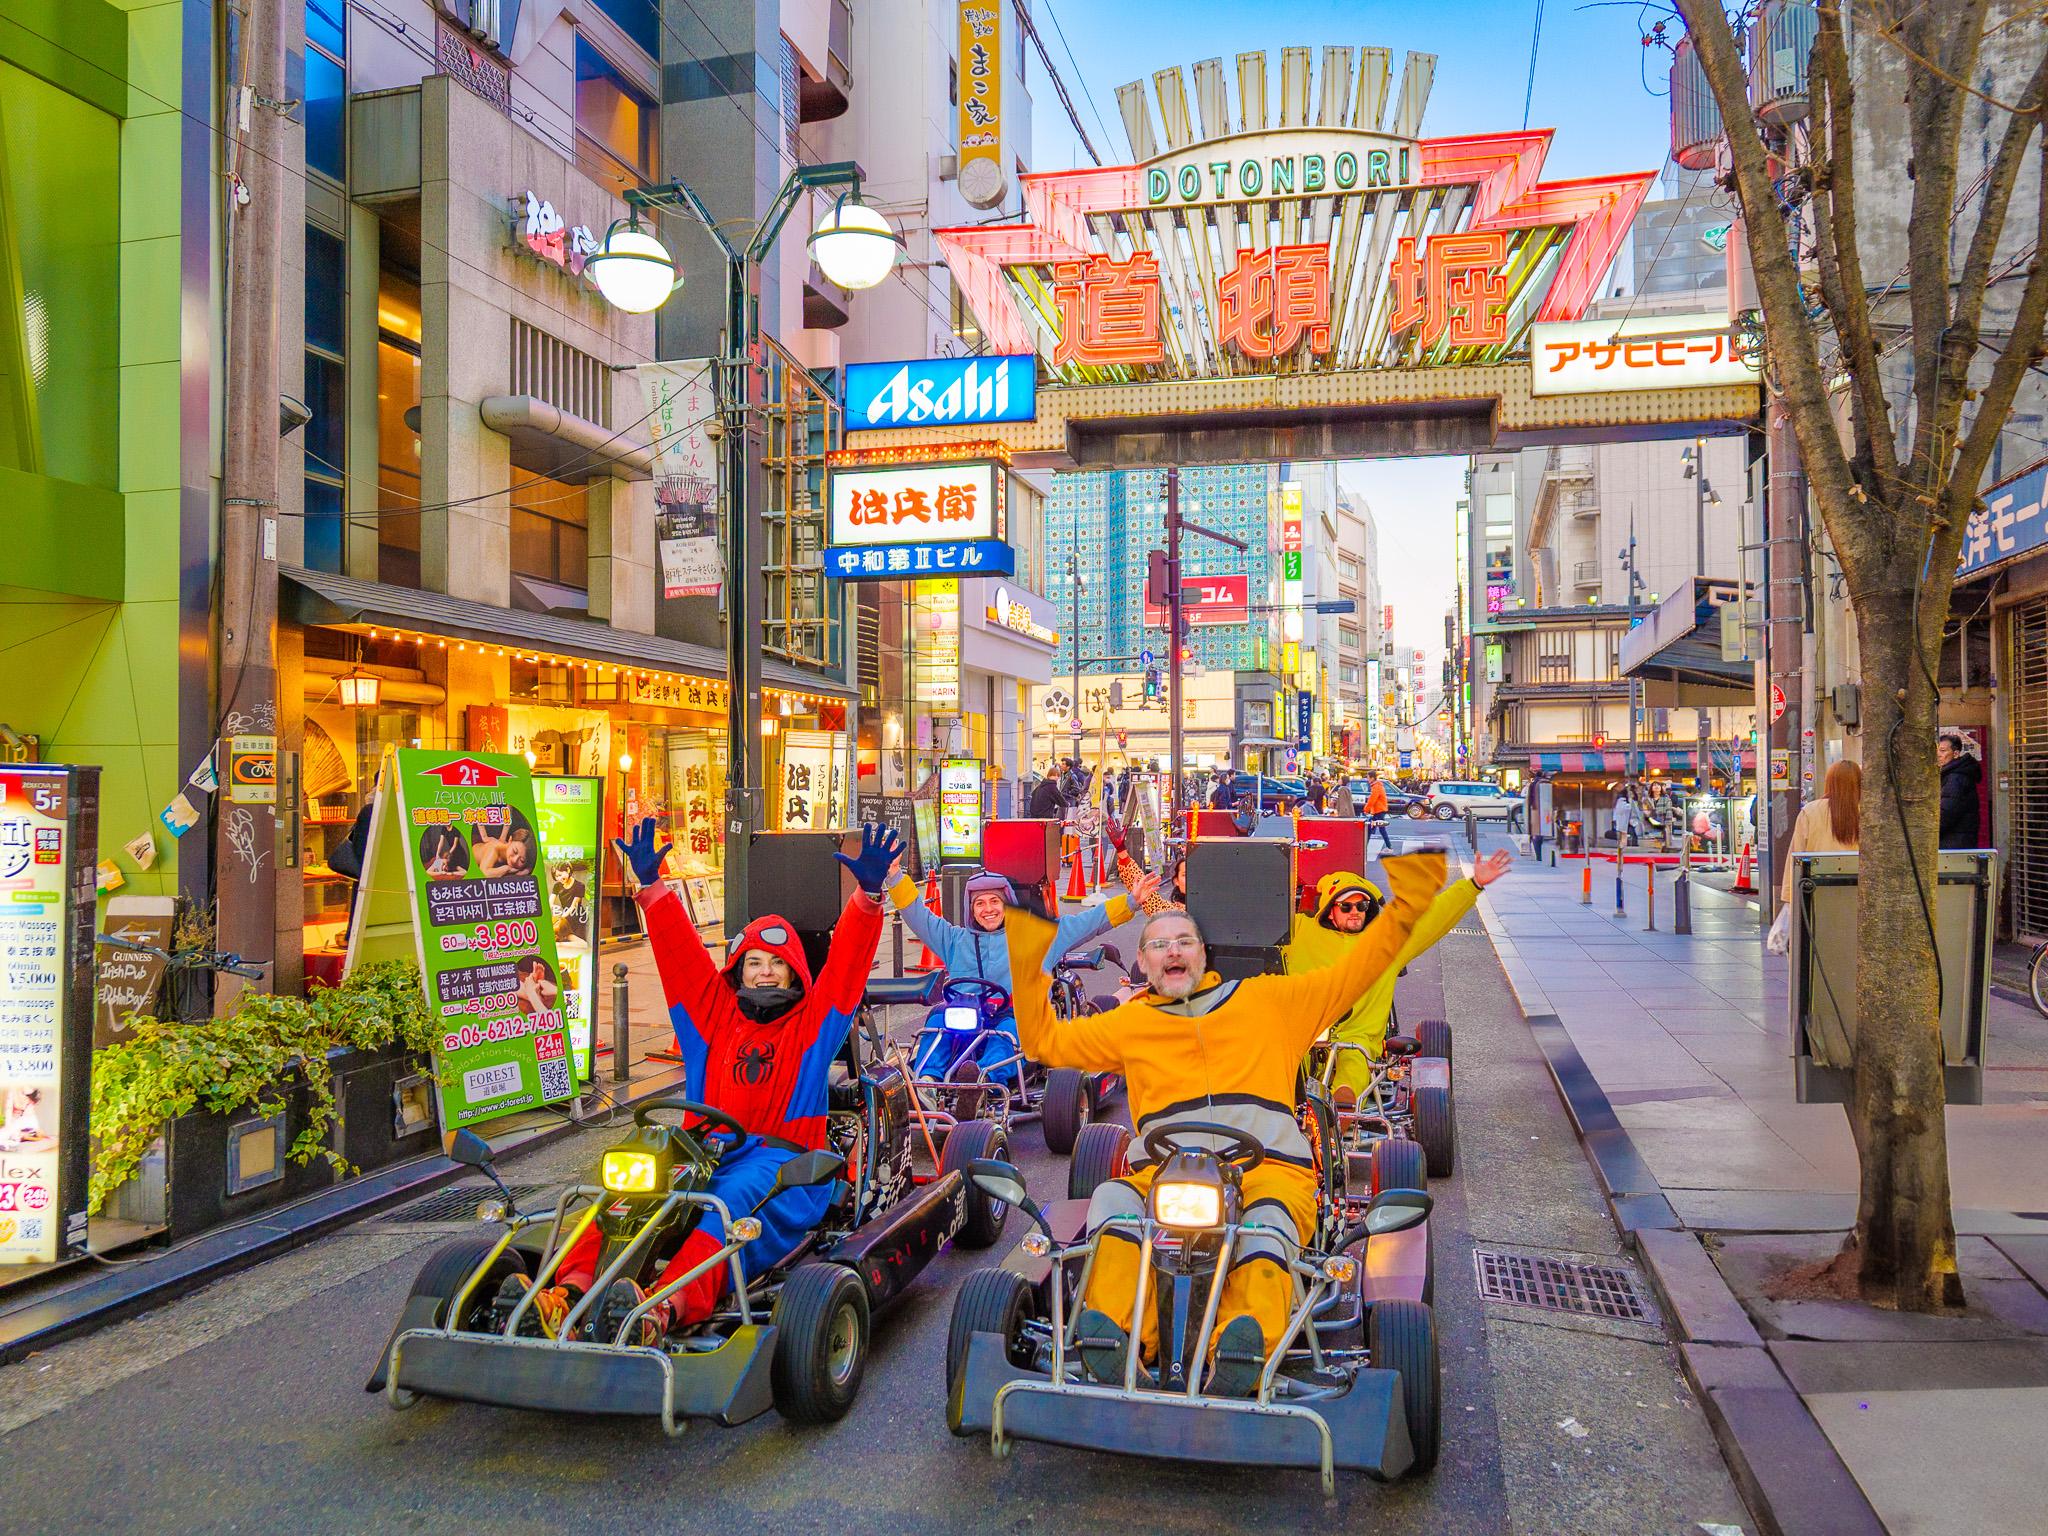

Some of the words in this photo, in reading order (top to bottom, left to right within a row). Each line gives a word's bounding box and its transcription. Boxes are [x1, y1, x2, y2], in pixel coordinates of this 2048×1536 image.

[1148, 147, 1410, 204] DOTONBORI
[1054, 232, 1507, 366] 道頓堀
[867, 358, 1009, 424] Asahi
[849, 483, 977, 526] 治兵衛
[1957, 471, 2048, 569] 洋モー
[1200, 586, 1234, 604] コム
[932, 687, 956, 696] KARIN
[459, 764, 480, 785] 2F
[35, 789, 62, 811] 5F
[249, 791, 273, 799] 大阪
[785, 763, 811, 830] 治兵
[431, 883, 483, 900] もみほぐし
[488, 880, 536, 896] MASSAGE
[435, 904, 456, 922] 본격
[456, 903, 484, 920] 마사지
[492, 899, 538, 917] 正宗按摩
[550, 904, 590, 923] Body
[19, 920, 57, 932] Massage
[467, 919, 538, 951] ¥3,800
[112, 951, 153, 962] GUINNESS
[100, 961, 125, 979] Irish
[124, 964, 147, 980] Pub
[476, 966, 491, 980] FOOT
[491, 963, 516, 977] MASSAGE
[441, 988, 450, 1000] 발
[451, 984, 475, 999] 마사지
[464, 991, 518, 1014] ¥5,000
[460, 1009, 564, 1047] 06-6212-7401
[537, 1035, 563, 1053] 24H
[469, 1066, 516, 1087] FOREST
[483, 1083, 507, 1097] 道頓堀
[457, 1093, 535, 1121] http://www.d-forest.jp
